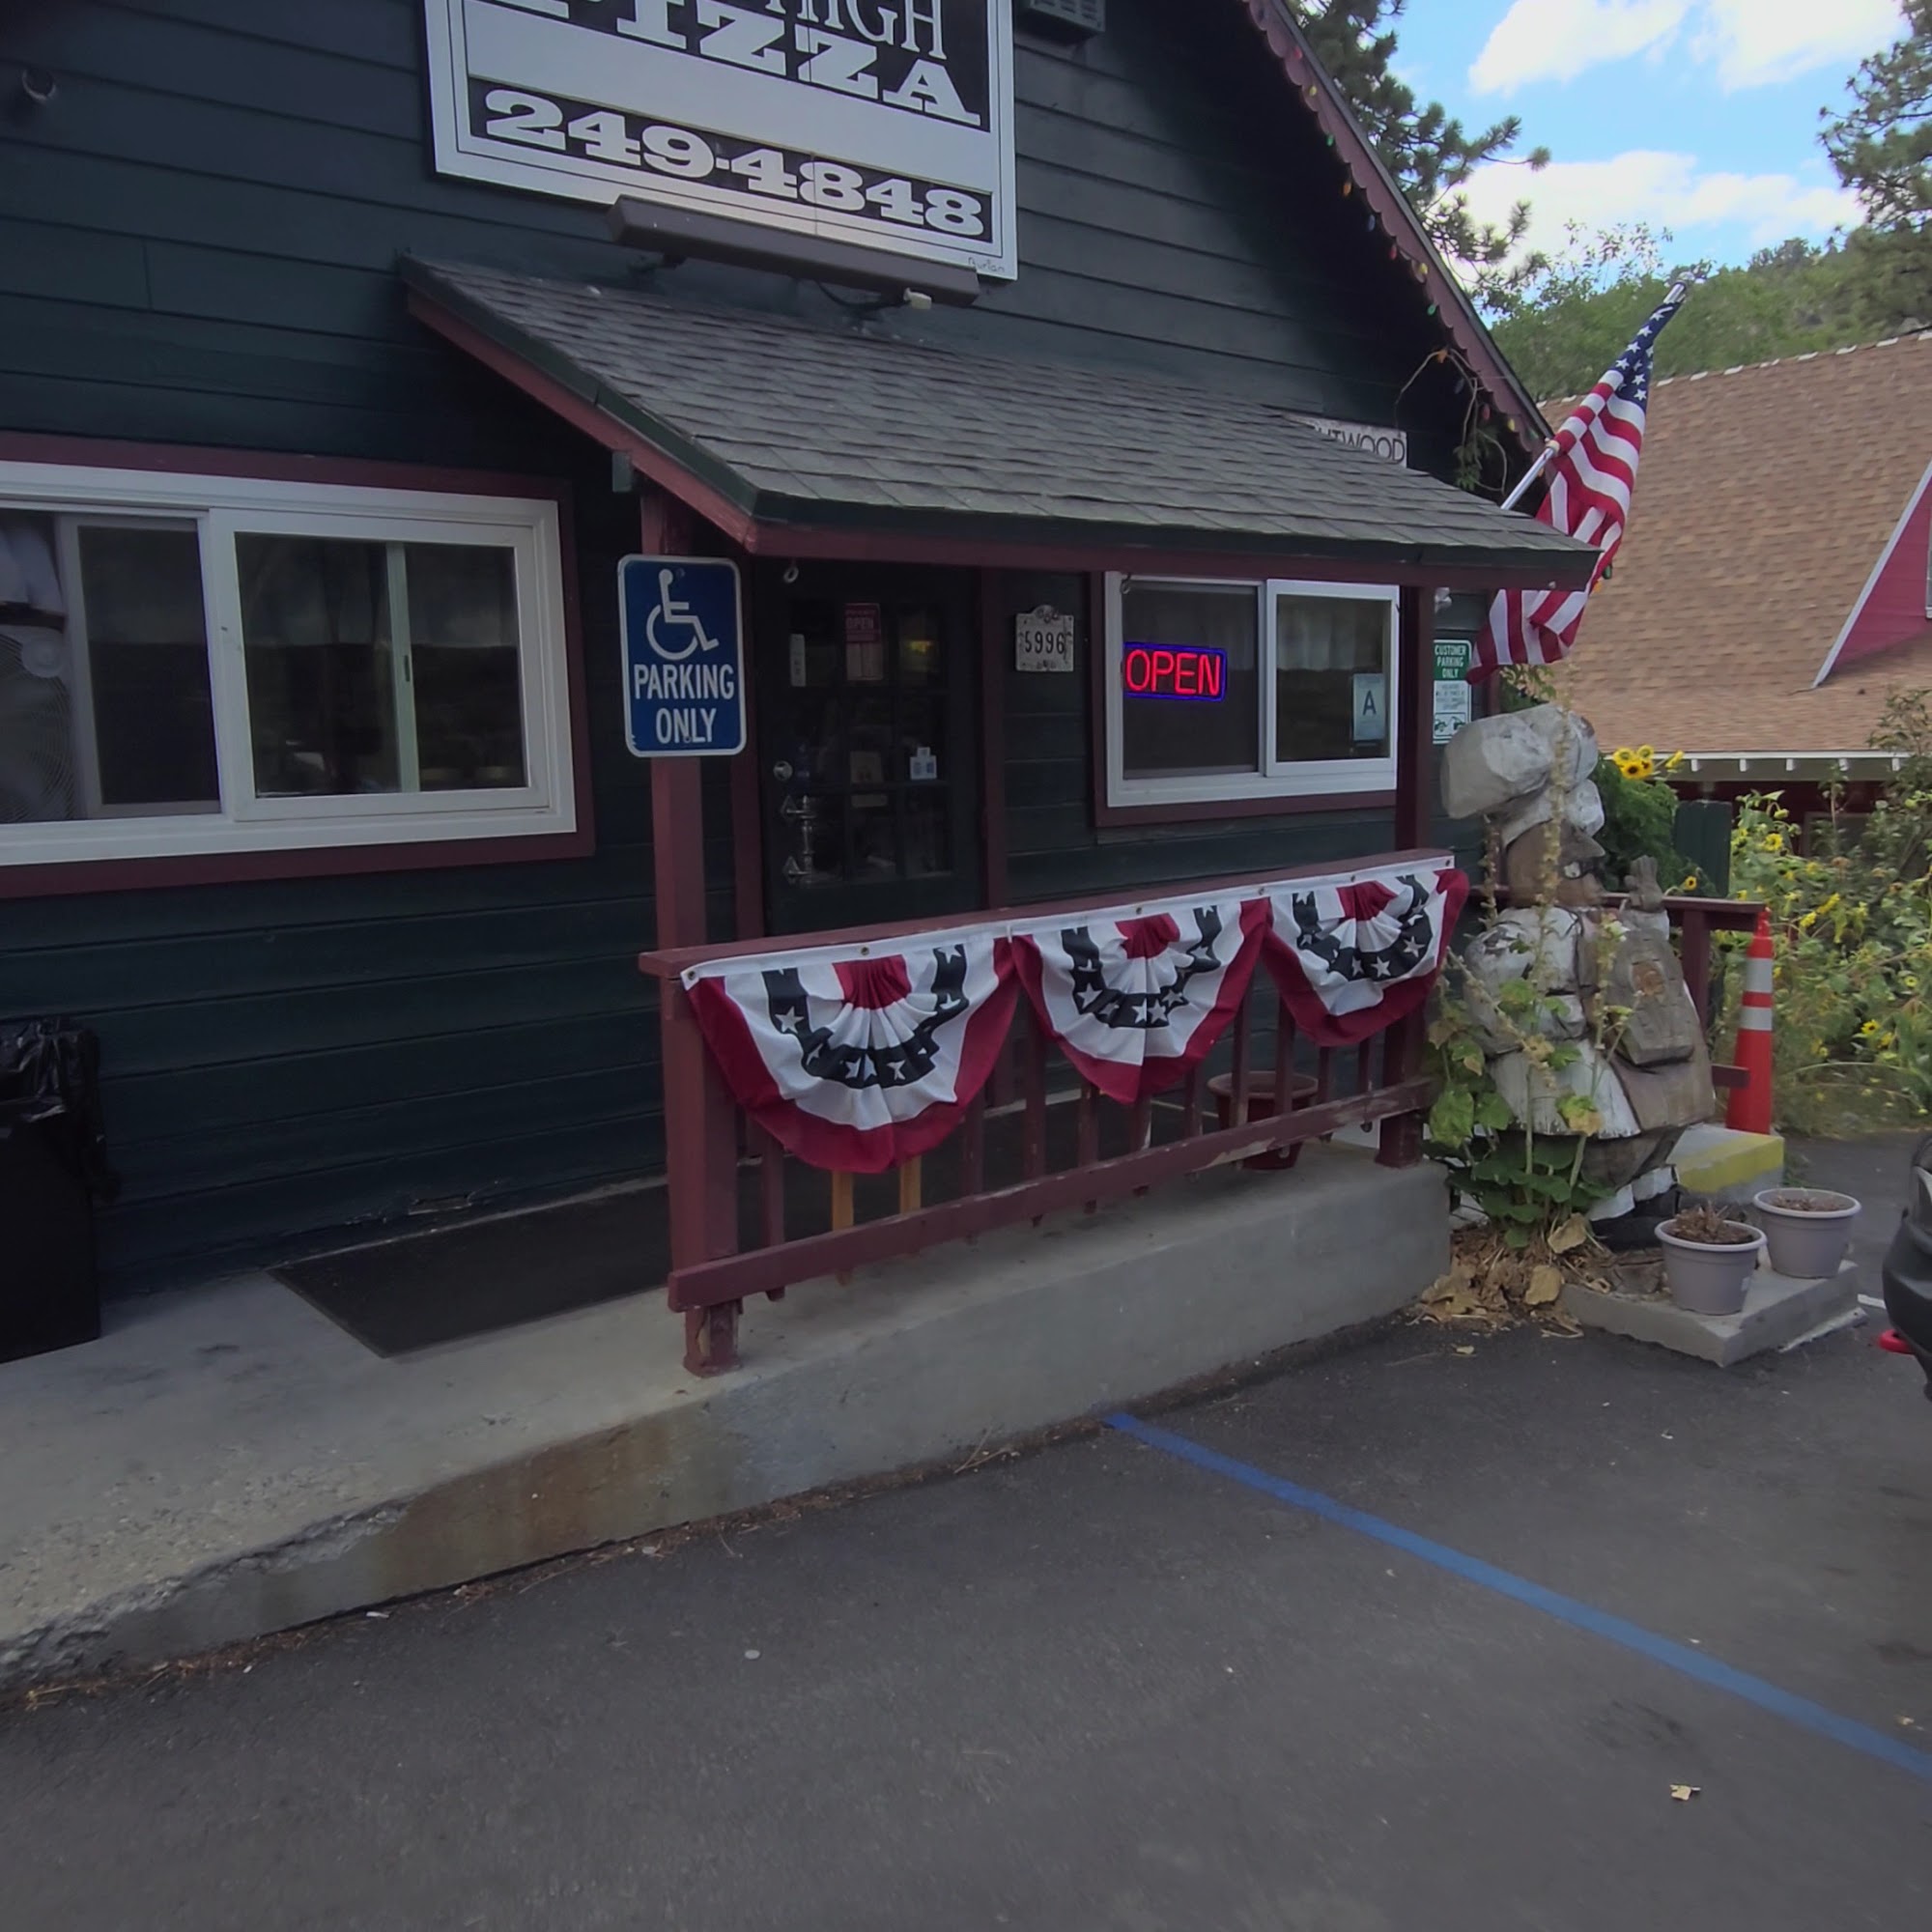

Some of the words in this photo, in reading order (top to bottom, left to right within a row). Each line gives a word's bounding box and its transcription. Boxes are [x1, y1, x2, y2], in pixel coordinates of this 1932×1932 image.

[491, 0, 980, 126] IZZA
[485, 89, 983, 236] 249-4848
[1024, 630, 1065, 655] 5996
[1434, 644, 1467, 656] CUSTOMER
[1125, 649, 1221, 696] OPEN
[1436, 656, 1464, 668] PARKING
[1442, 668, 1460, 679] ONLY
[634, 664, 735, 699] PARKING
[1362, 690, 1378, 716] A
[655, 707, 717, 744] ONLY
